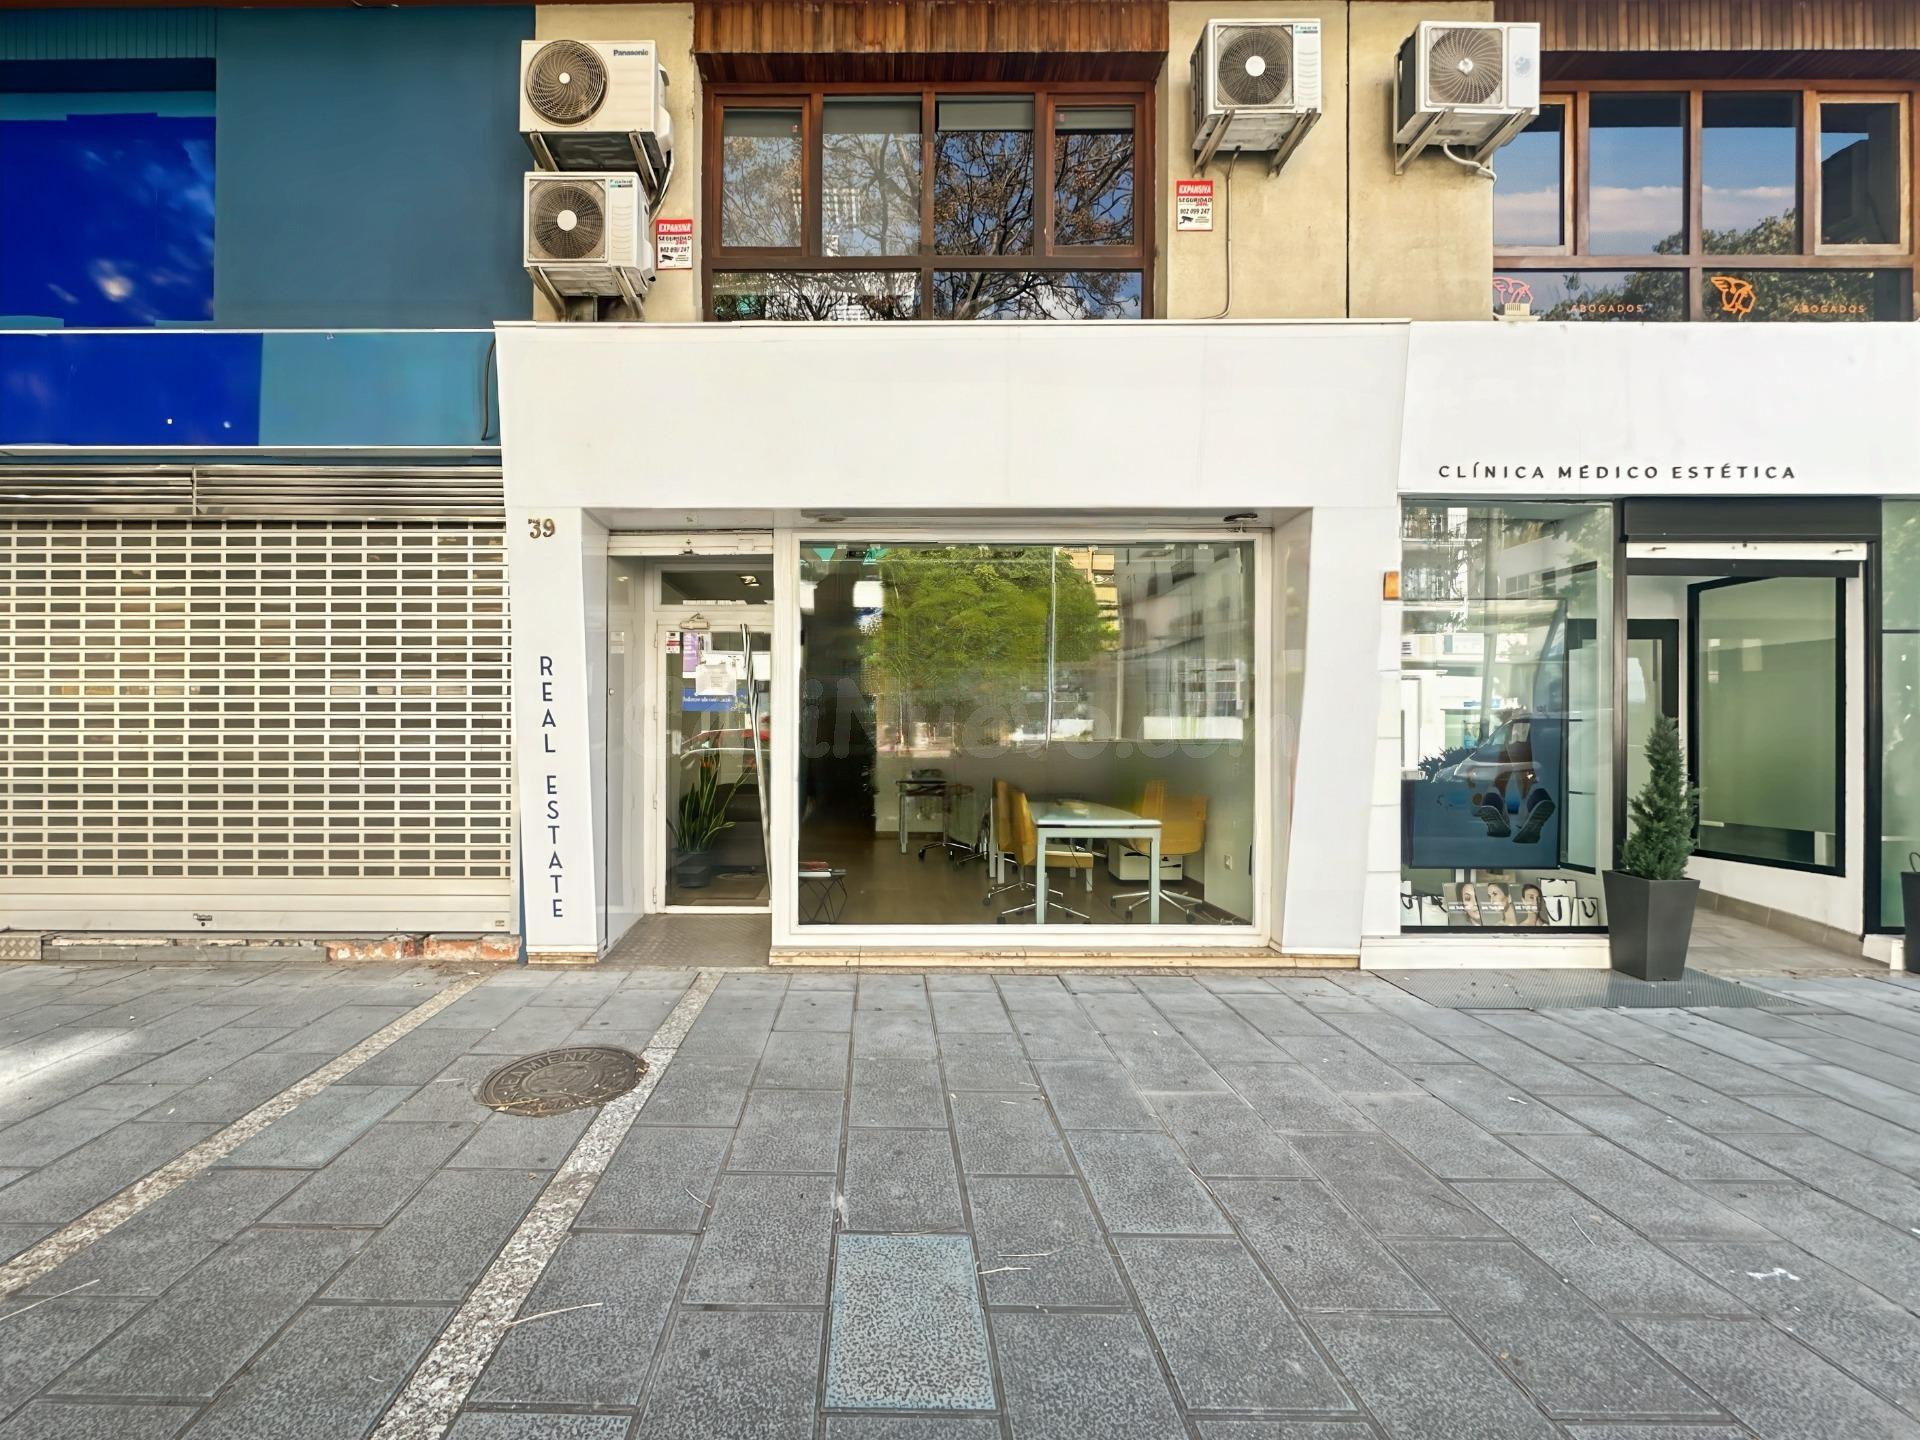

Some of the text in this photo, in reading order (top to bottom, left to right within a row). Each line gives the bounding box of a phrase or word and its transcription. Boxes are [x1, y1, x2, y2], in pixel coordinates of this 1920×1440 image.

[613, 48, 649, 57] Panasonic
[1570, 304, 1643, 313] ABOGADOS
[1792, 304, 1865, 313] ABOGADOS
[1439, 462, 1795, 479] CLÍNICA MÉDICO ESTÉTICA
[528, 518, 555, 539] 39
[540, 655, 564, 918] REAL ESTATE
